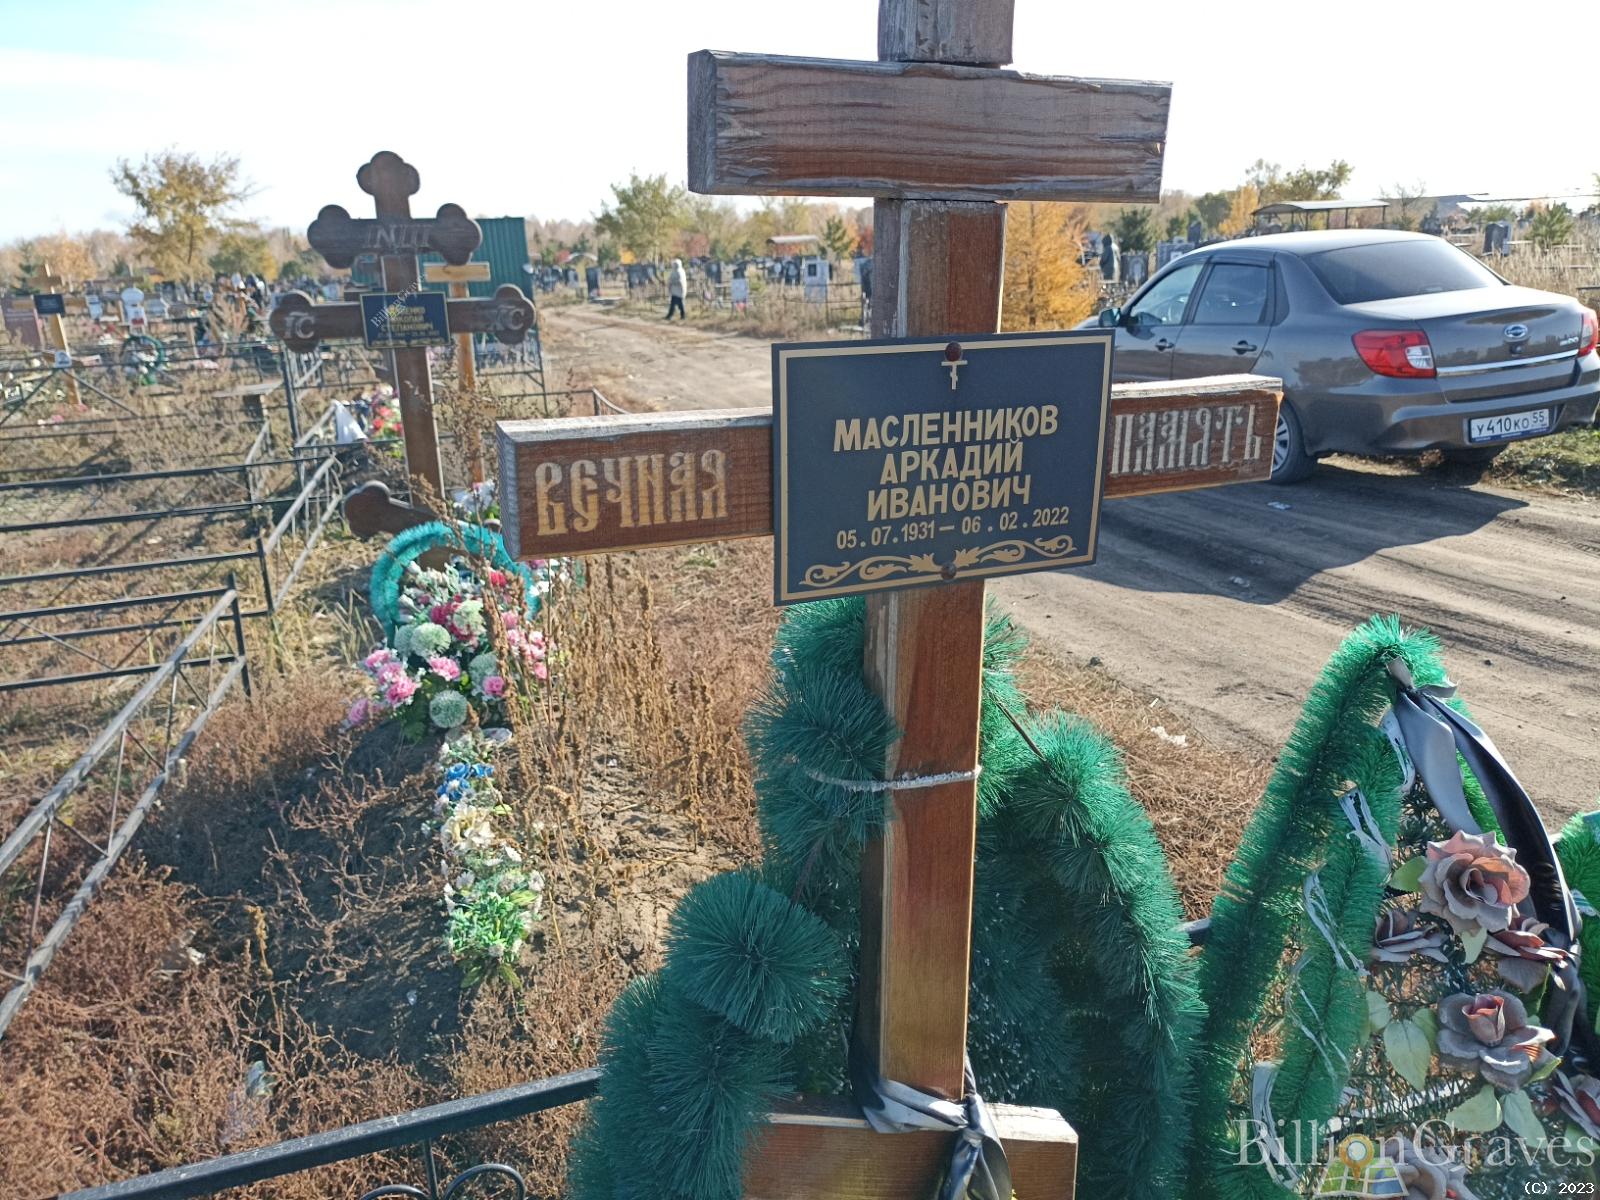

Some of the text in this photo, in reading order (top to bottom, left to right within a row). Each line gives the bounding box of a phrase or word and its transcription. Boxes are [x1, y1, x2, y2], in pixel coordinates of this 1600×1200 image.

[833, 404, 1059, 452] МАСЛЕННИКОВ
[879, 436, 1024, 485] АРКАДИЙ
[867, 474, 1032, 522] ИВАНОВИЧ
